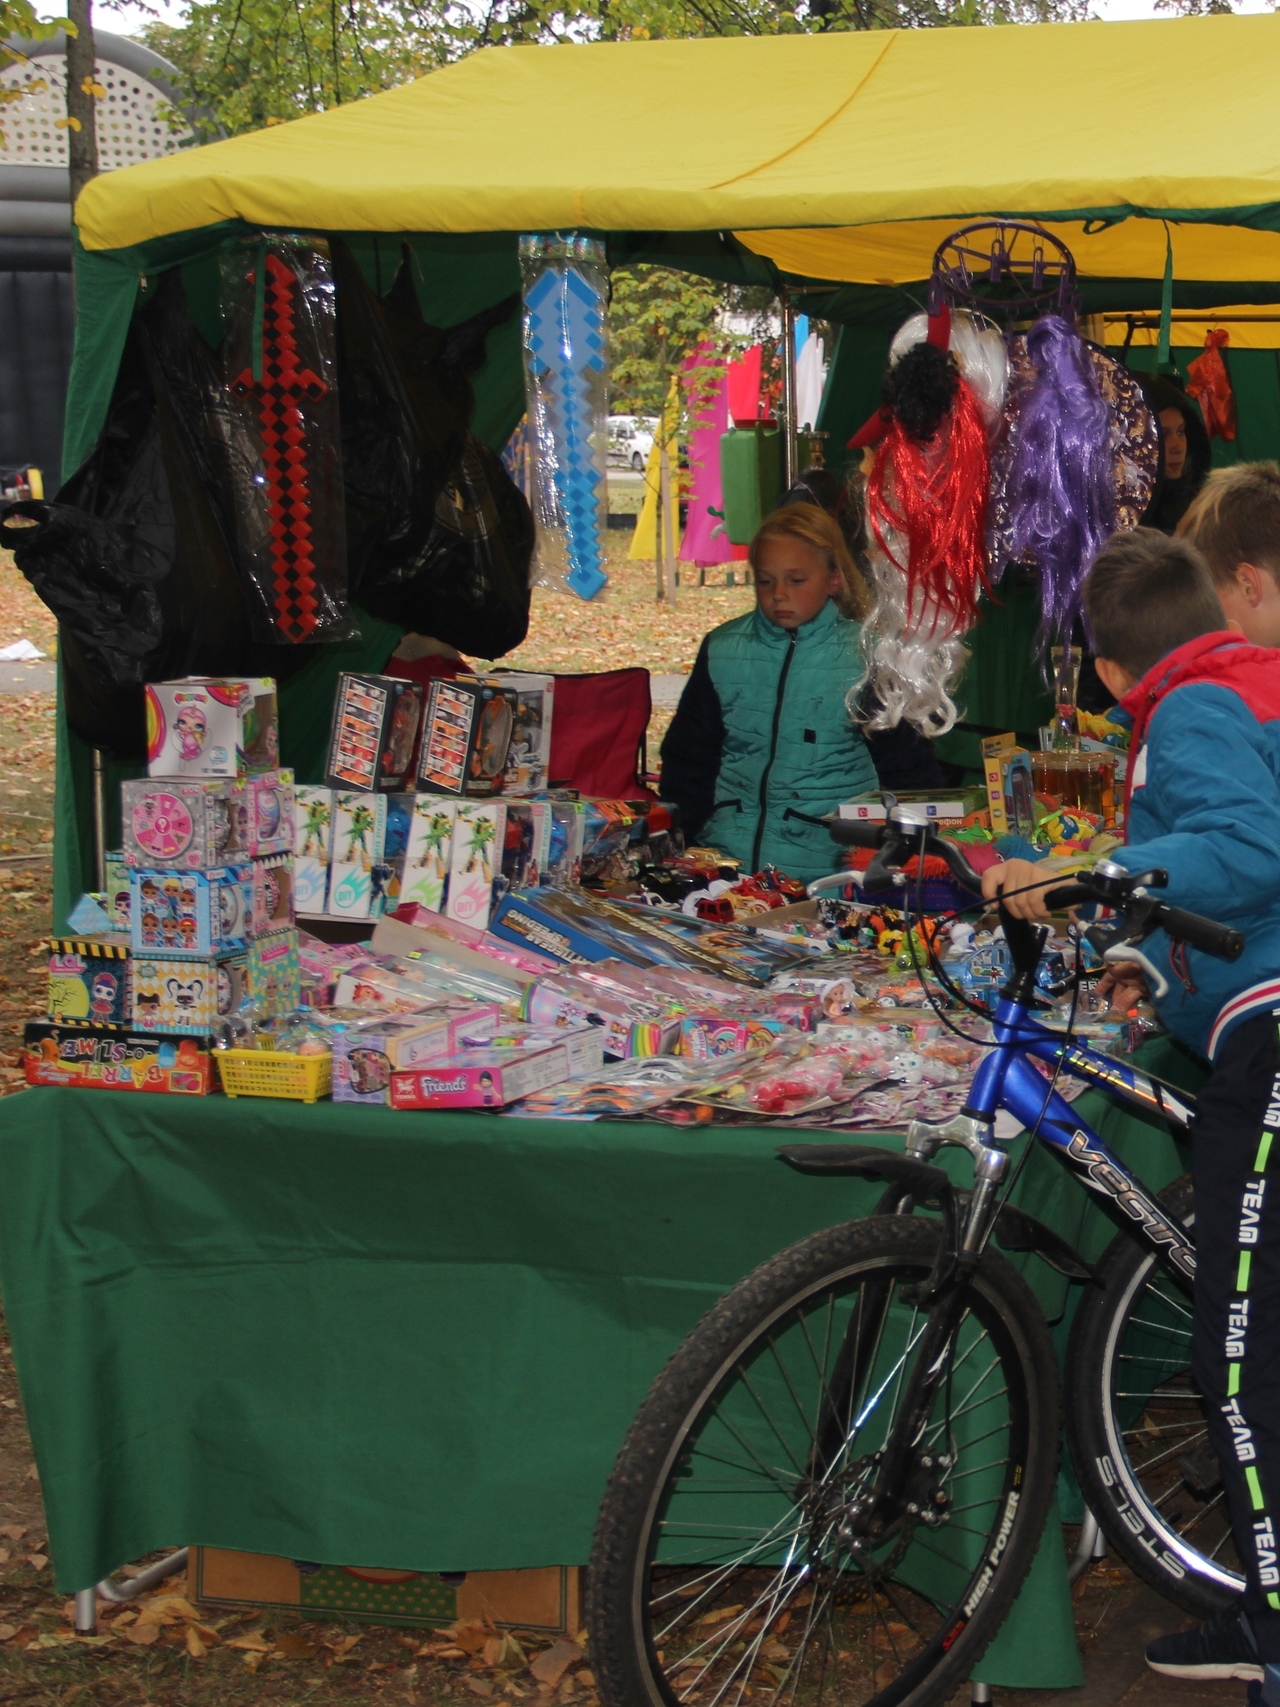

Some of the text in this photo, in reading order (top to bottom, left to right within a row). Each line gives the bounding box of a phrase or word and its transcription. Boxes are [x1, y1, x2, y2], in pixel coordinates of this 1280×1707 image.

[81, 1061, 164, 1088] BARREL
[1238, 1178, 1266, 1244] TEAM
[1224, 1299, 1249, 1358] TEAM
[1221, 1398, 1256, 1461] TEAM
[1094, 1454, 1189, 1580] STELS
[963, 1490, 1020, 1619] HIGH POWER
[1253, 1517, 1280, 1586] TEAM
